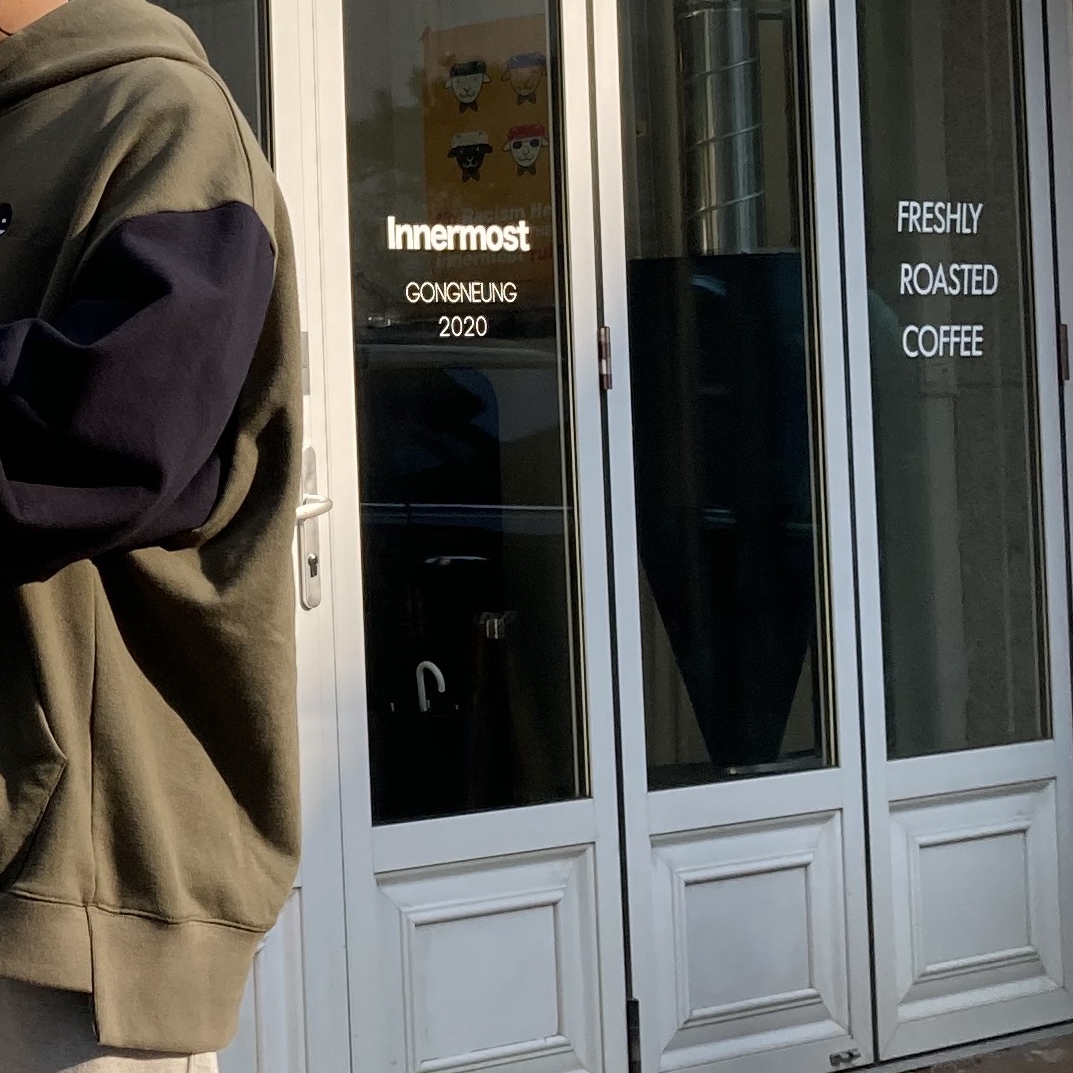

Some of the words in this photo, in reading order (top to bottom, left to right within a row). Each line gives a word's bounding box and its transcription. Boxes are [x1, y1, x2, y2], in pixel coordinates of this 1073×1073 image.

[387, 215, 531, 252] Innermost
[897, 200, 983, 234] FRESHLY
[405, 281, 518, 304] GONGNEUNG
[900, 262, 998, 296] ROASTED
[438, 315, 488, 337] 2020
[902, 324, 984, 358] COFFEE
